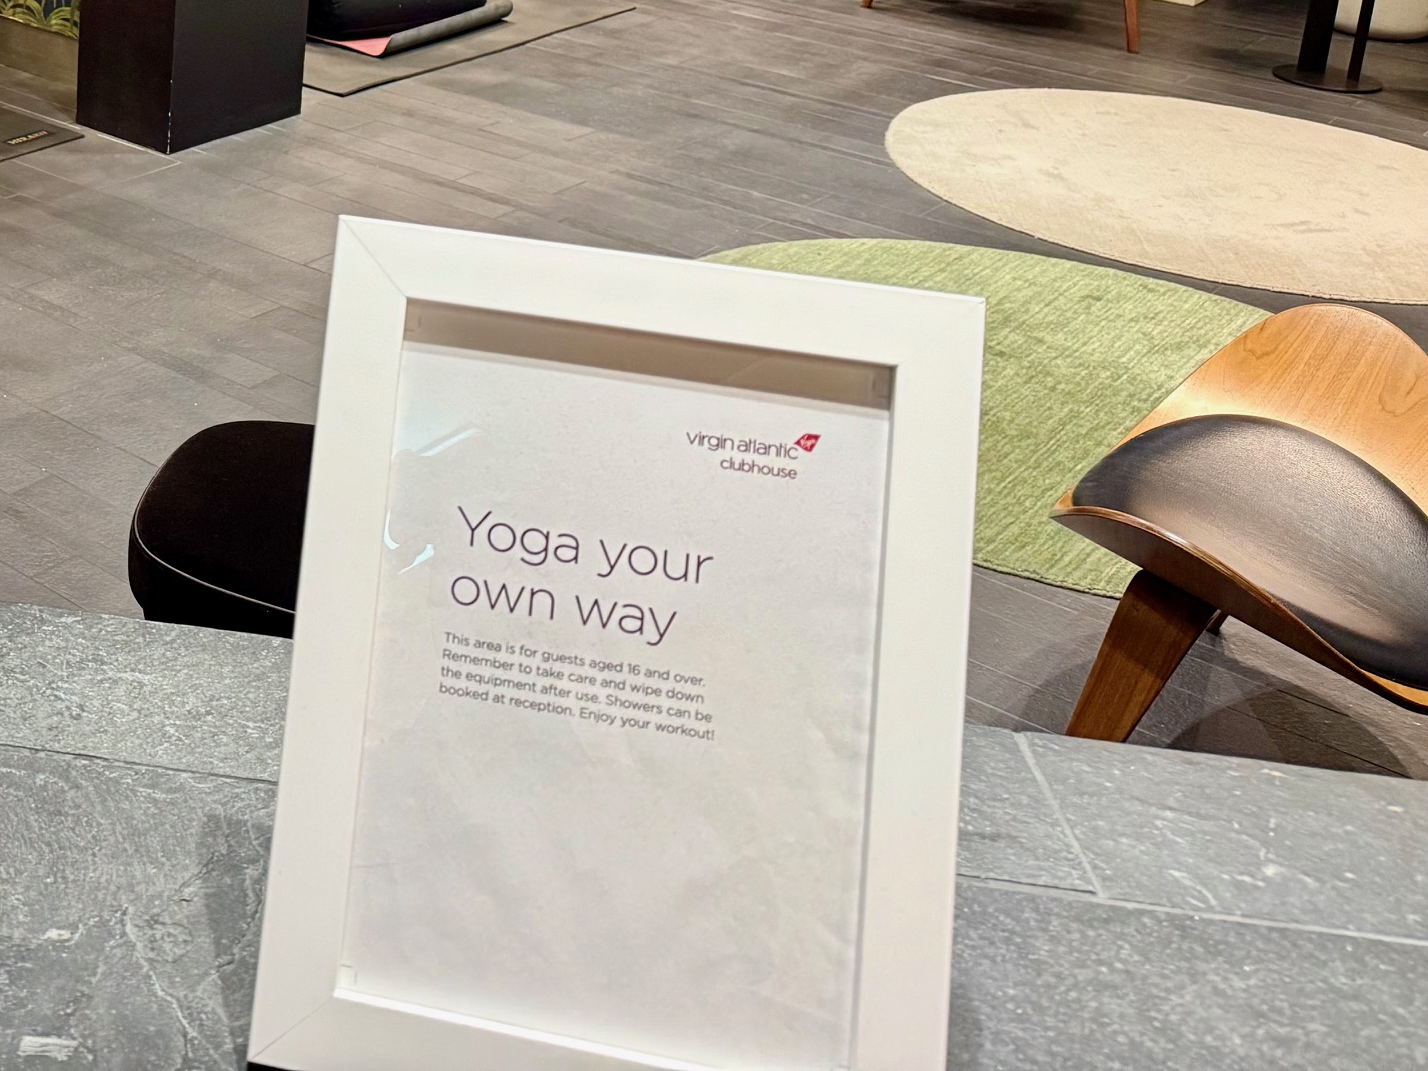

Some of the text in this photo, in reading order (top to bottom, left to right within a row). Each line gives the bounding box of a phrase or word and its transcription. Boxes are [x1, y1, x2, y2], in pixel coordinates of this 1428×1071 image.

[686, 431, 734, 451] virgin
[737, 438, 798, 460] atlantic
[720, 456, 797, 479] clubhouse
[457, 506, 713, 584] Yoga your
[451, 576, 677, 646] own way
[442, 649, 704, 704] Remember to take care and wipe down
[445, 632, 706, 687] This area is for guests aged 16 and over.
[439, 682, 715, 741] booked at reception. Enjoy your workout!
[441, 666, 713, 723] the equipment after use. Showers can be
